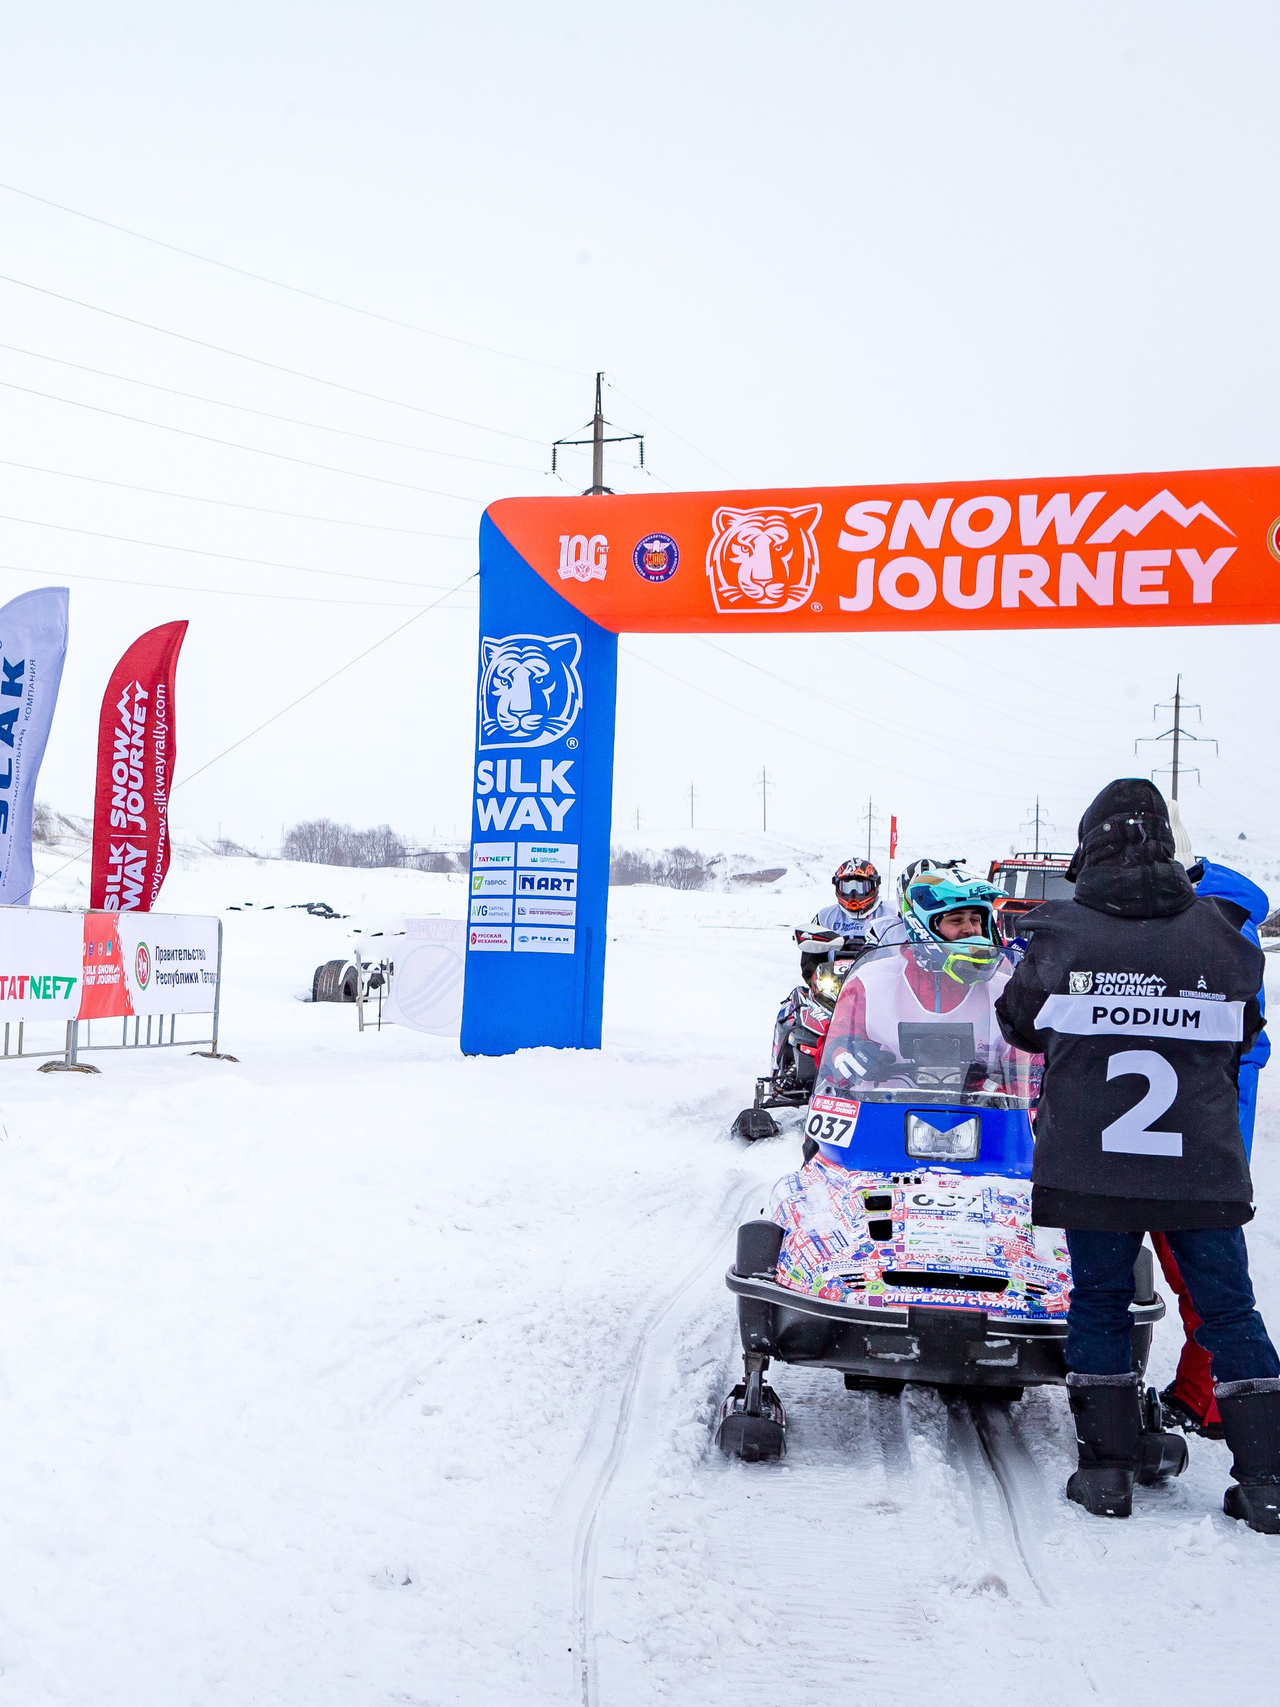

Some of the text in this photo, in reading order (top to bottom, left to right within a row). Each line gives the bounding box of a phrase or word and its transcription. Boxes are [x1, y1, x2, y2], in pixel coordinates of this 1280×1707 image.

[837, 491, 1107, 552] SNOW
[838, 546, 1238, 611] JOURNEY
[24, 658, 36, 721] КОМПАНИЯ
[476, 759, 576, 795] SILK
[120, 680, 148, 910] WAY JOURNEY
[104, 726, 131, 910] SILK SNOW
[476, 797, 576, 832] WAY
[521, 876, 574, 891] NART
[472, 905, 488, 916] AVG
[155, 946, 206, 964] Правительство
[156, 969, 199, 988] Республики
[1094, 984, 1168, 997] JOURNEY
[1095, 972, 1145, 984] SNOW
[1092, 1006, 1201, 1029] PODIUM
[1102, 1050, 1183, 1156] 2
[808, 1114, 852, 1142] 037
[885, 1293, 1030, 1312] ОПЕРЕЖАЯ СТИХИЮ
